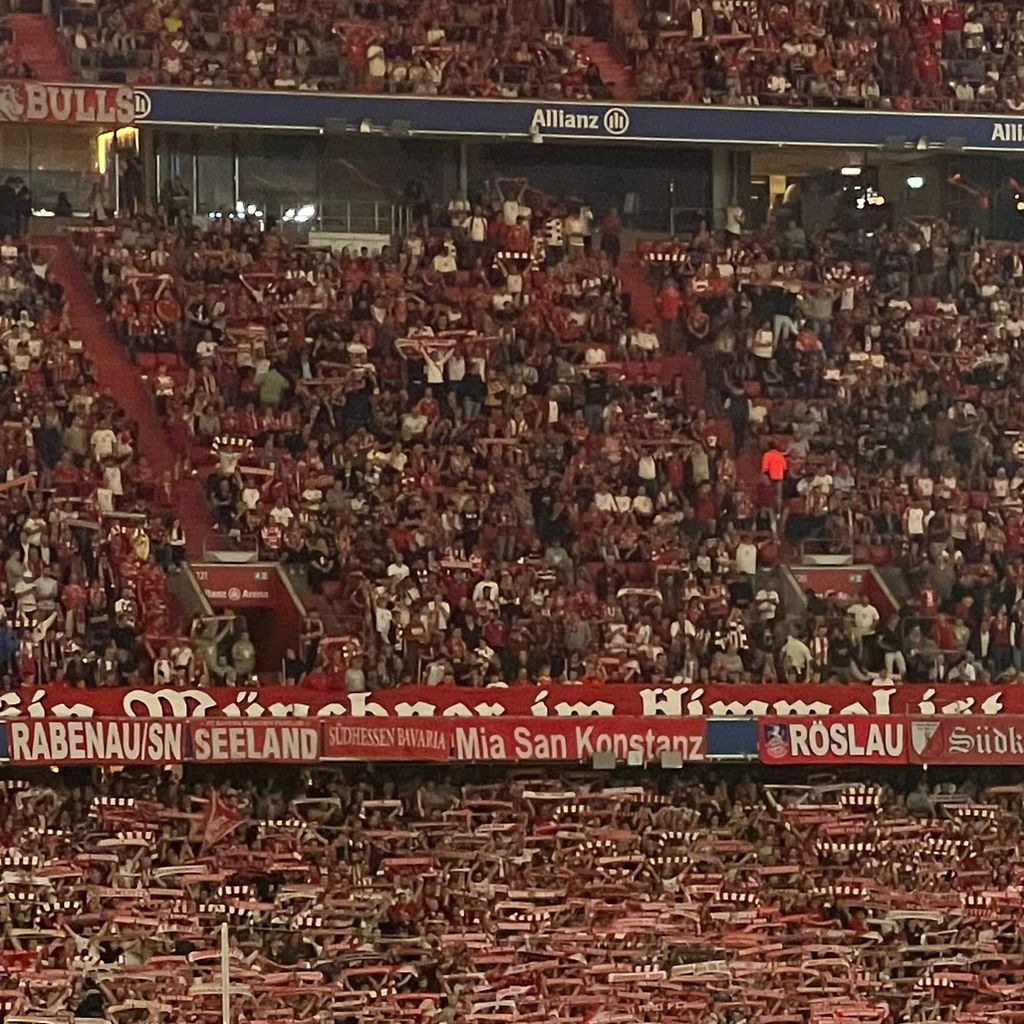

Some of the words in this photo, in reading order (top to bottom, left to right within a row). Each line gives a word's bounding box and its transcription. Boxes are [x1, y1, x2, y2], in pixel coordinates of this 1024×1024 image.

[26, 84, 135, 123] BULLS
[532, 109, 599, 129] Allianz
[11, 721, 182, 760] RABENAU/SN
[195, 727, 318, 760] SEELAND
[329, 723, 395, 747] SÜDHESSEN
[397, 727, 446, 750] BAVARIA
[456, 726, 505, 759] Mia
[514, 726, 567, 759] San
[575, 725, 704, 761] Konstanz
[789, 720, 904, 757] RÖSLAU
